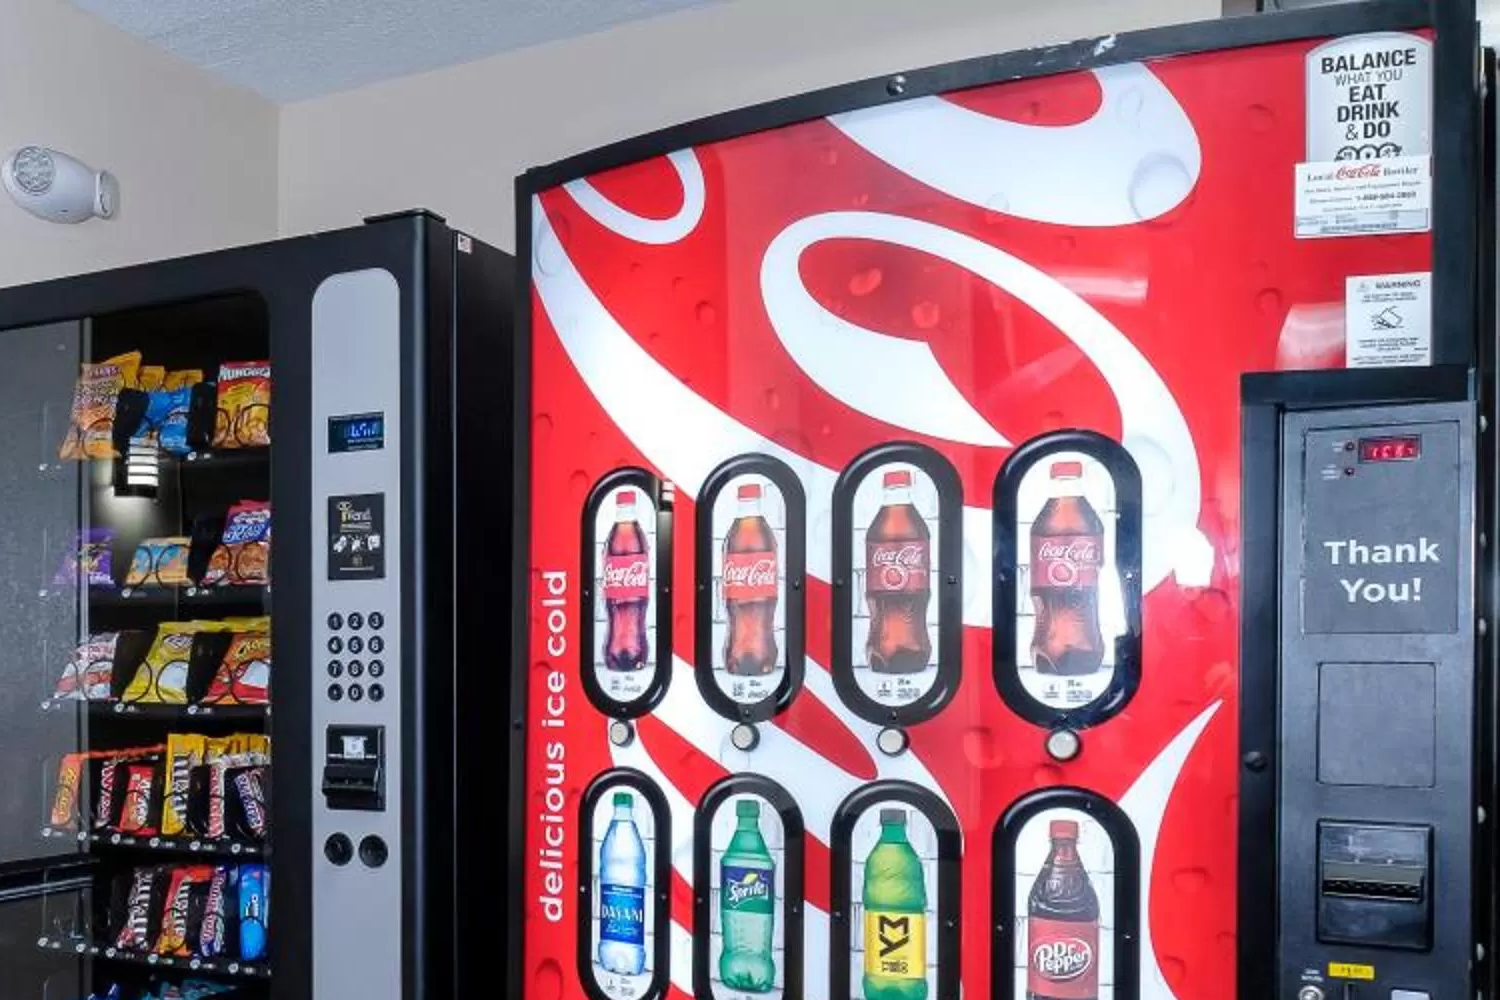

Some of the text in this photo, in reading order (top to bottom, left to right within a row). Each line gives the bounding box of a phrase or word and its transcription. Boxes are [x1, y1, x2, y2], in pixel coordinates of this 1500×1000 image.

[1321, 48, 1417, 74] BALANCE
[1334, 68, 1403, 86] WHAT YOU
[1349, 83, 1387, 102] EAT
[1337, 101, 1399, 122] DRINK
[1345, 120, 1391, 140] & DO
[1323, 537, 1440, 565] Thank
[1340, 577, 1422, 603] You!
[539, 571, 567, 922] delicious ice cold
[728, 880, 766, 902] Sprite
[1034, 944, 1088, 974] Pepper
[1053, 941, 1077, 957] Dr
